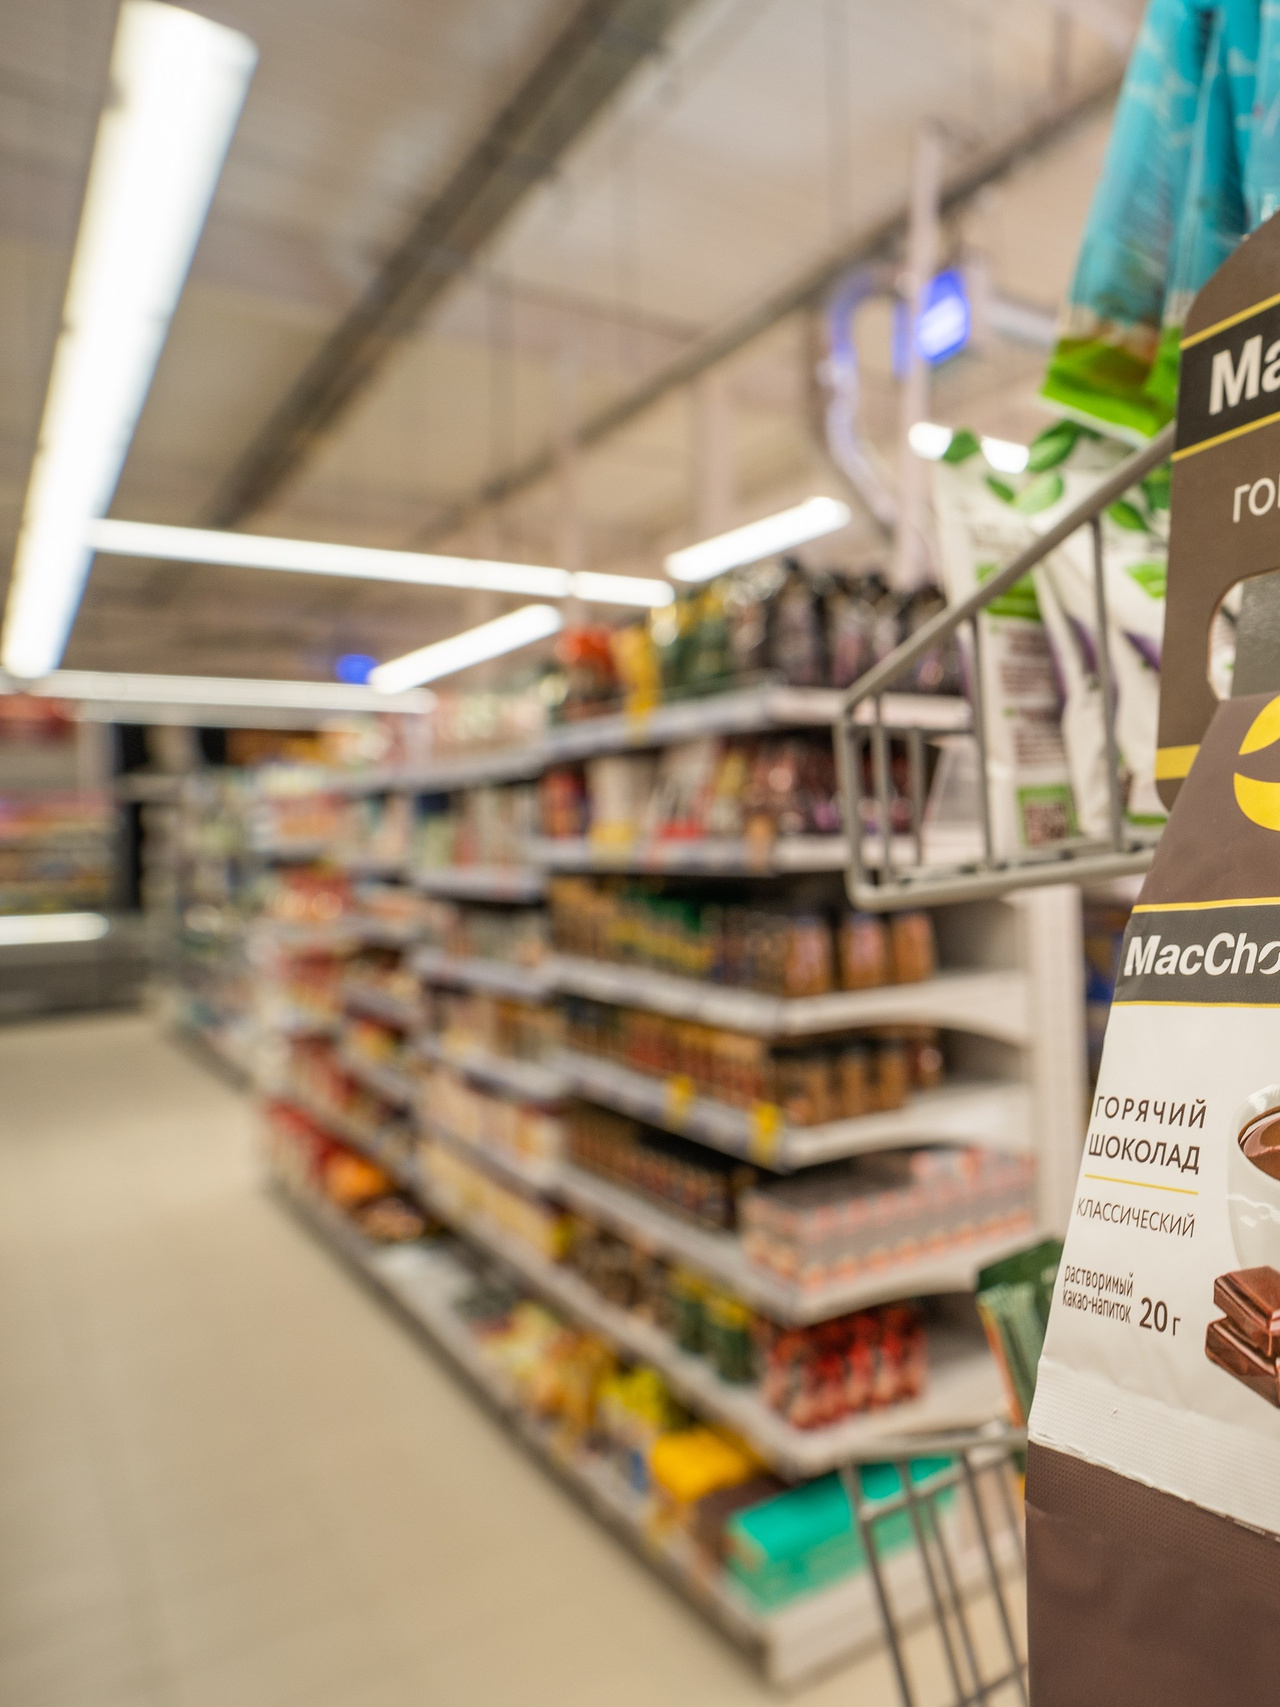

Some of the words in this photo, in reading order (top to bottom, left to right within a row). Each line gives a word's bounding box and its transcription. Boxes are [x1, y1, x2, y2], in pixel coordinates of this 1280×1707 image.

[1094, 1095, 1208, 1129] ГОРЯЧИЙ
[1088, 1133, 1201, 1176] ШОКОЛАД
[1076, 1197, 1196, 1239] КЛАССИЧЕСКИЙ
[1063, 1265, 1134, 1298] растворимый
[1062, 1288, 1132, 1325] какао-напиток
[1139, 1296, 1168, 1333] 20
[1172, 1316, 1181, 1337] г
